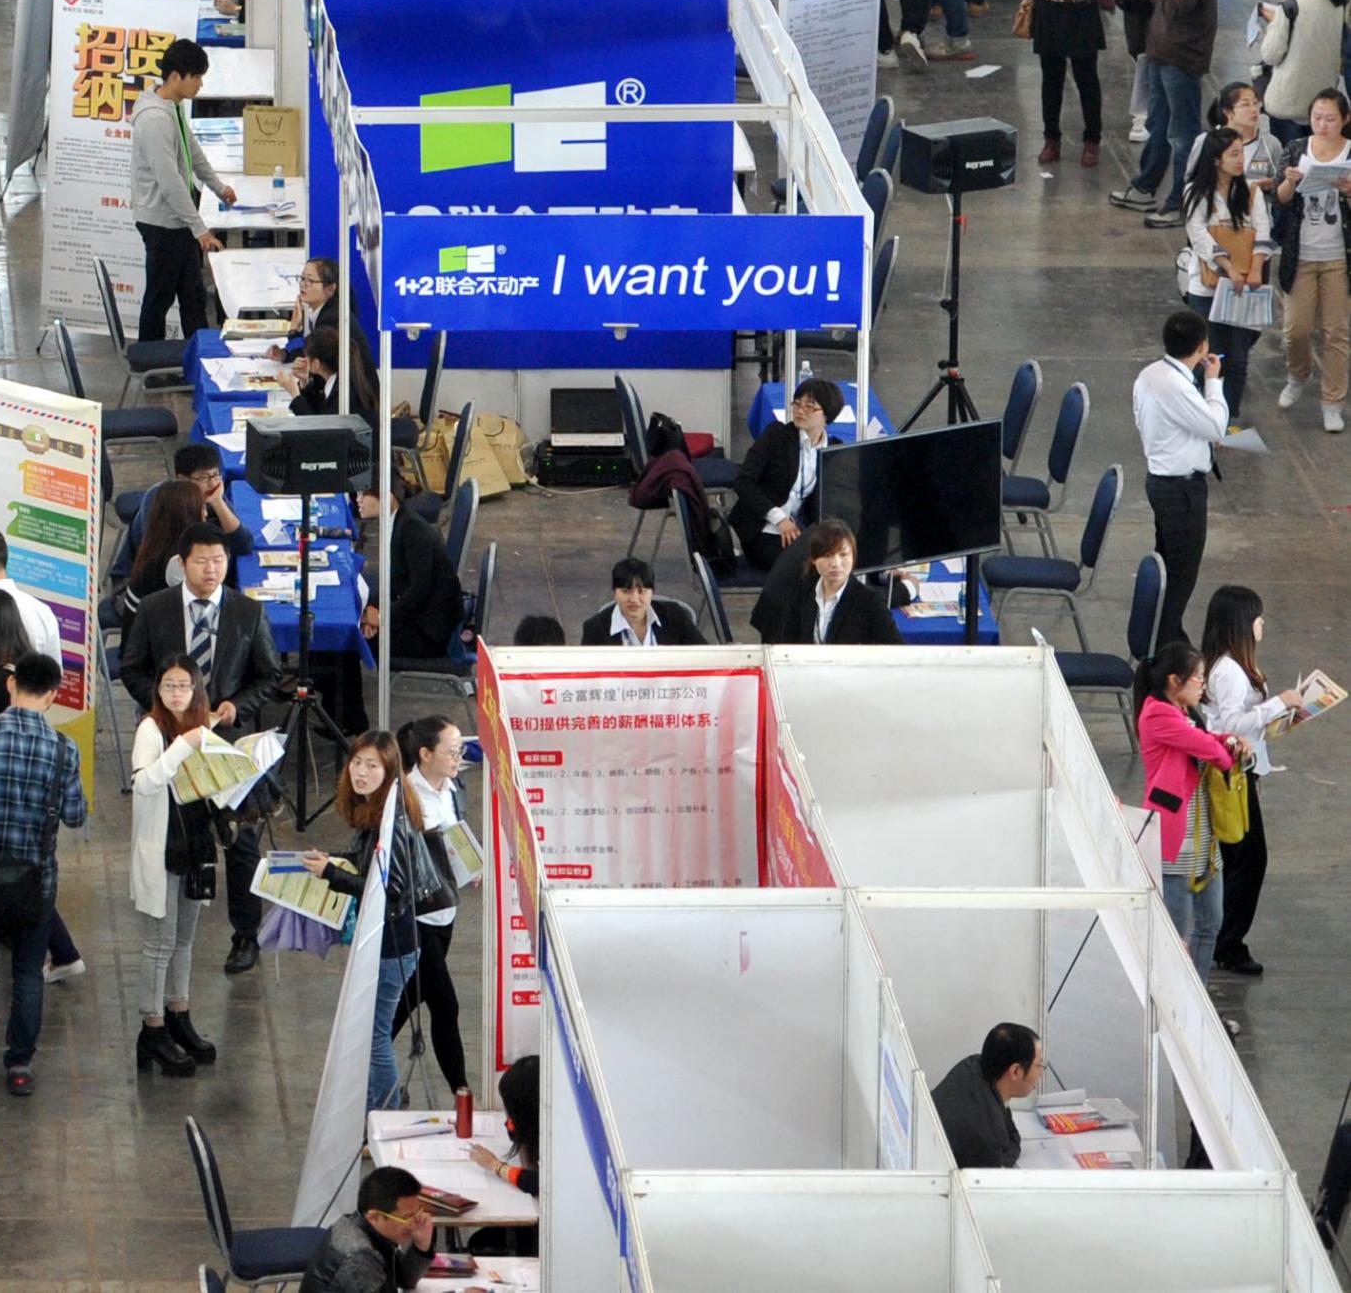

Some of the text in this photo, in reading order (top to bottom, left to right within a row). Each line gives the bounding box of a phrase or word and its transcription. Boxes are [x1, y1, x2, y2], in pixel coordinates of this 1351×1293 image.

[395, 276, 539, 296] 1+2联合不动产
[551, 254, 566, 295] I
[584, 256, 709, 296] want
